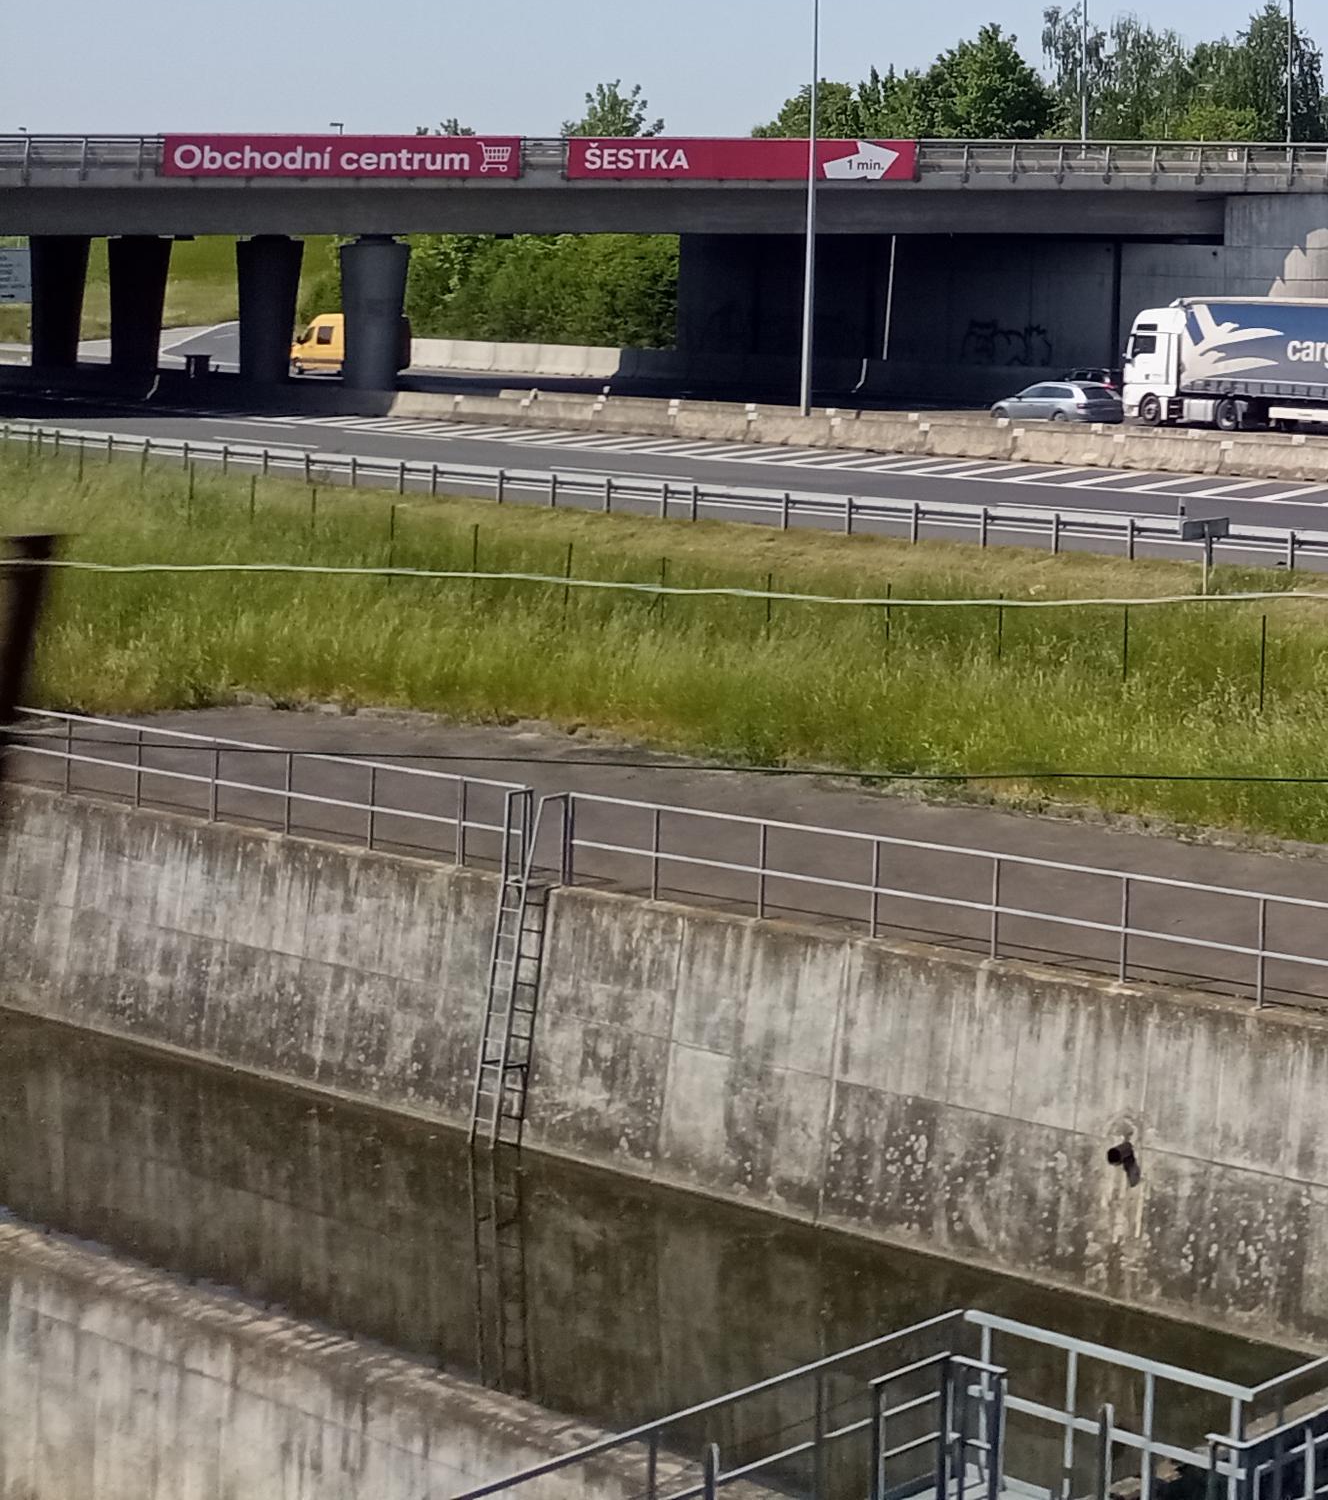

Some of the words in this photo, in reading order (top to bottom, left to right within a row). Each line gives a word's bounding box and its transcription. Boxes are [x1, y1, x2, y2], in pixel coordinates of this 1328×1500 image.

[173, 144, 332, 171] Obchodní
[339, 148, 470, 171] centrum
[584, 142, 690, 170] ŠESTKA
[847, 158, 854, 170] 1
[856, 158, 886, 171] min.
